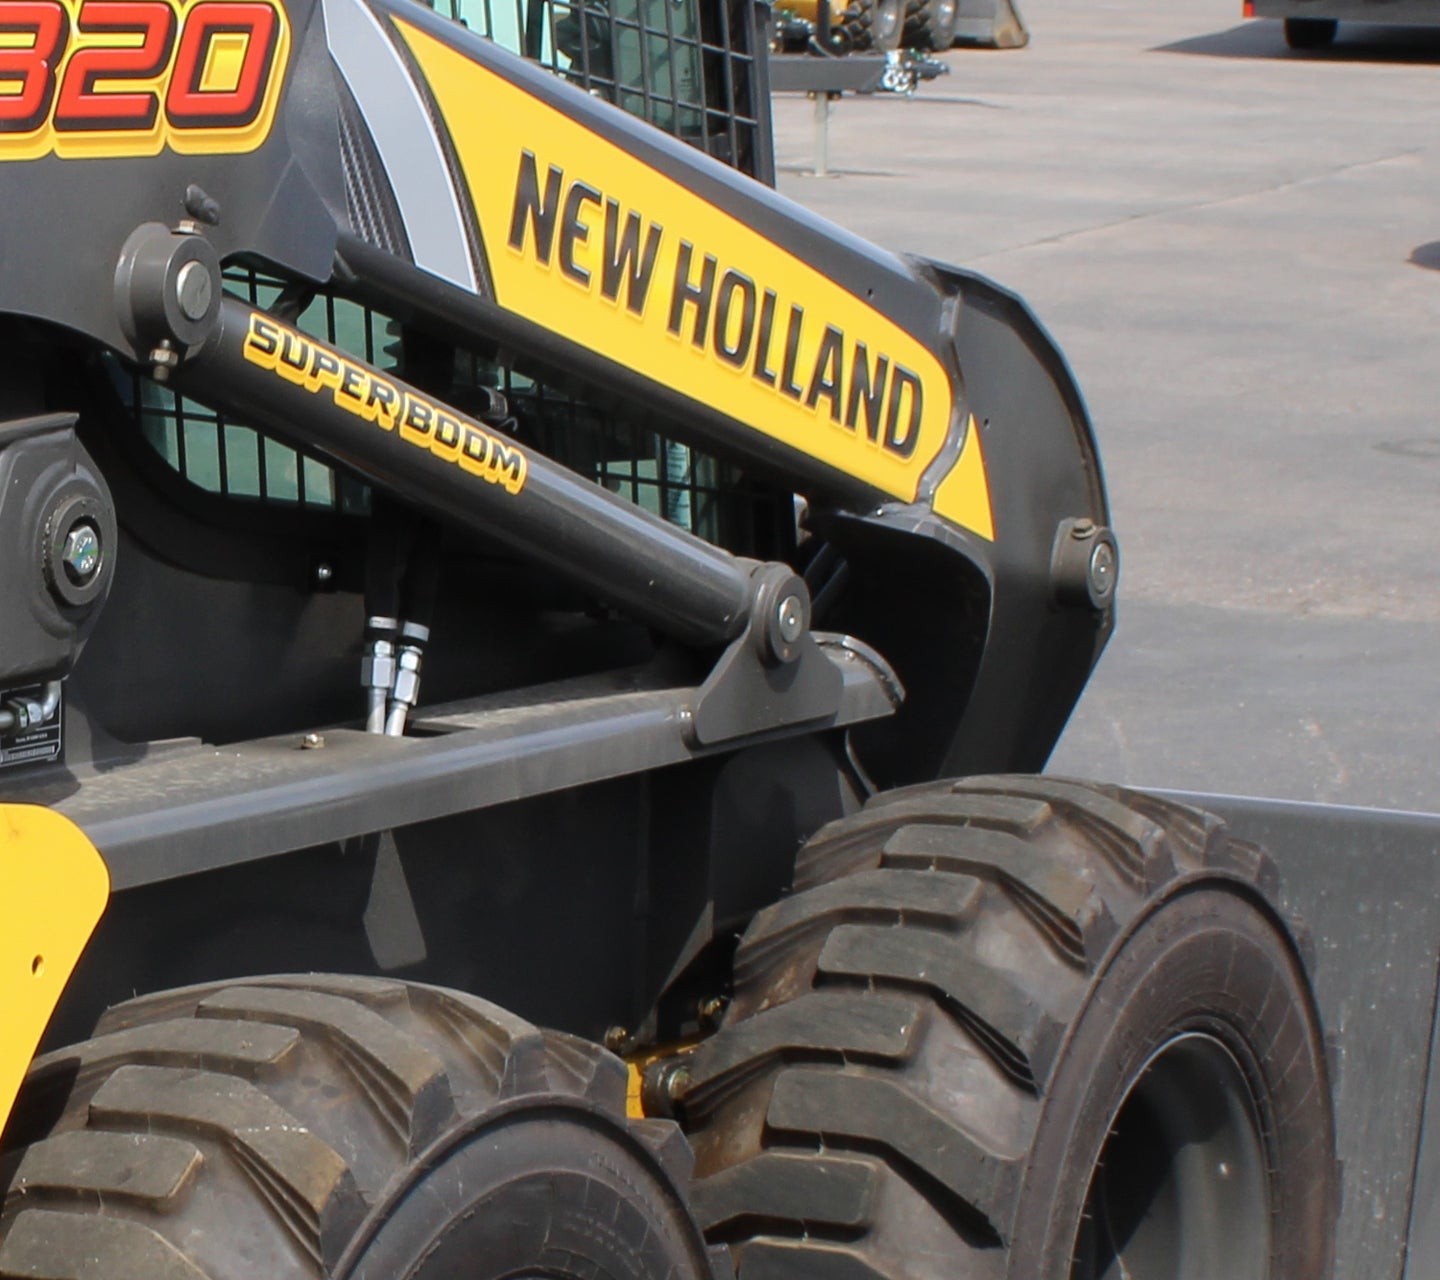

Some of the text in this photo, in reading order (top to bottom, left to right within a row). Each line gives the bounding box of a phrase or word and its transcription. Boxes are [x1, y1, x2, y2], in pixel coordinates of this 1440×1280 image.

[245, 311, 399, 427] SUPER
[401, 383, 528, 494] BOOM
[508, 150, 925, 462] NEW HOLLAND
